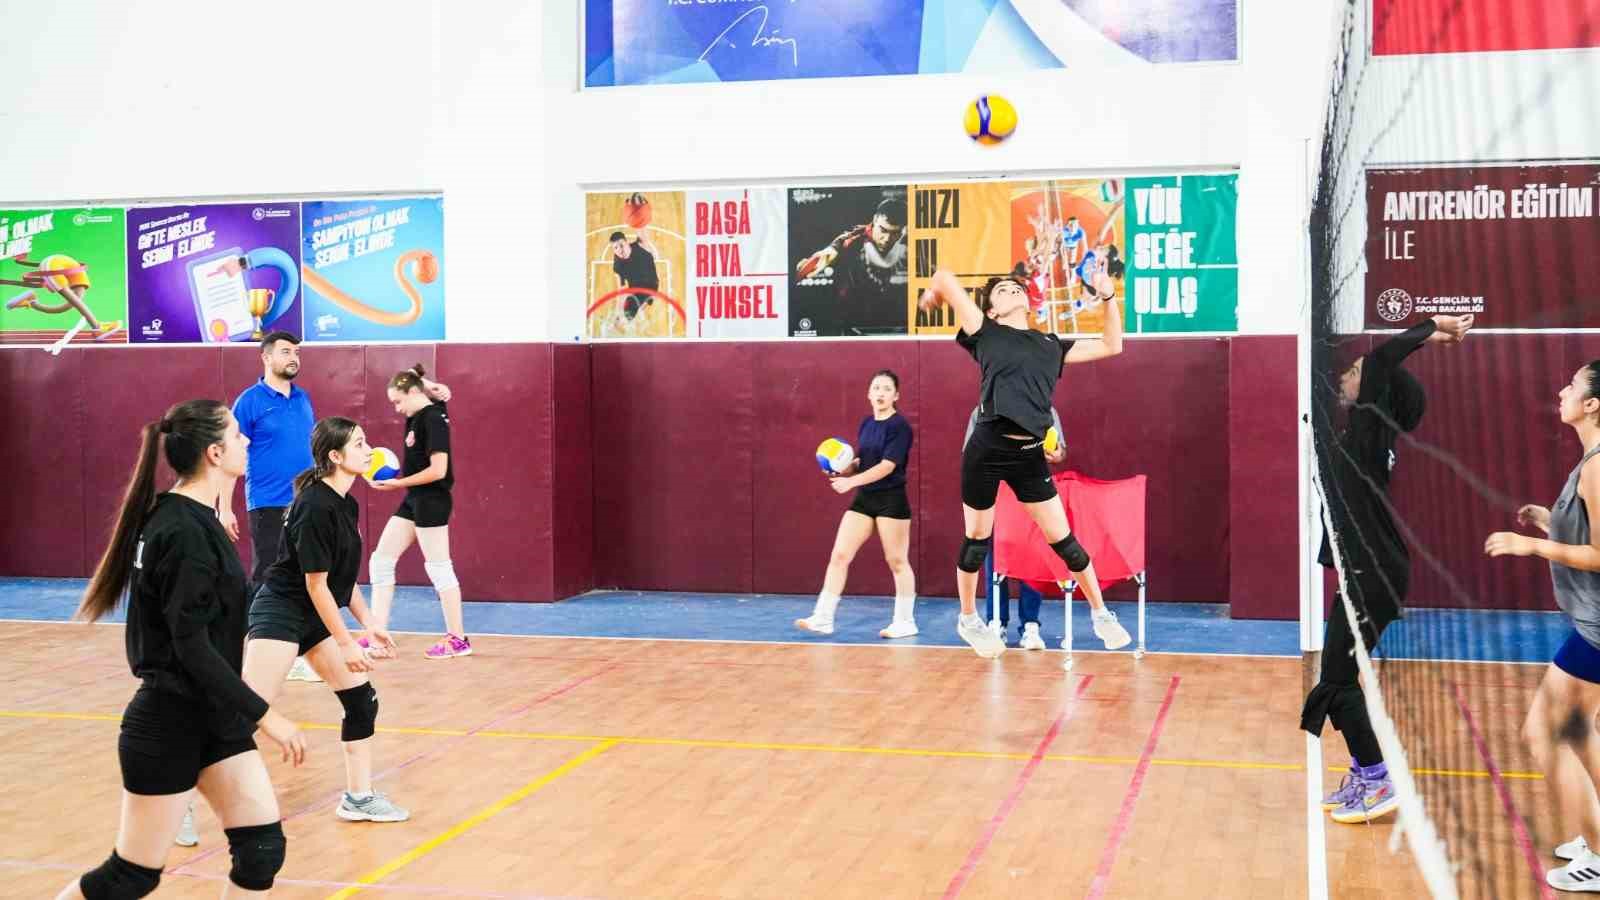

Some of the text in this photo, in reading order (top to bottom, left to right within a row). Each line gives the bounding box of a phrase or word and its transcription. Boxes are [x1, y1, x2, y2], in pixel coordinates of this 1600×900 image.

[915, 188, 960, 229] HIZI
[1134, 184, 1182, 225] YÜK
[1384, 184, 1505, 221] ANTRENÖR
[1511, 183, 1592, 218] EĞİTİM
[1384, 226, 1416, 260] İLE
[695, 281, 779, 319] YÜKSEL
[1134, 276, 1197, 319] ULAŞ
[1415, 296, 1431, 304] T.C.
[1471, 296, 1484, 304] VE
[1415, 305, 1437, 313] SPOR
